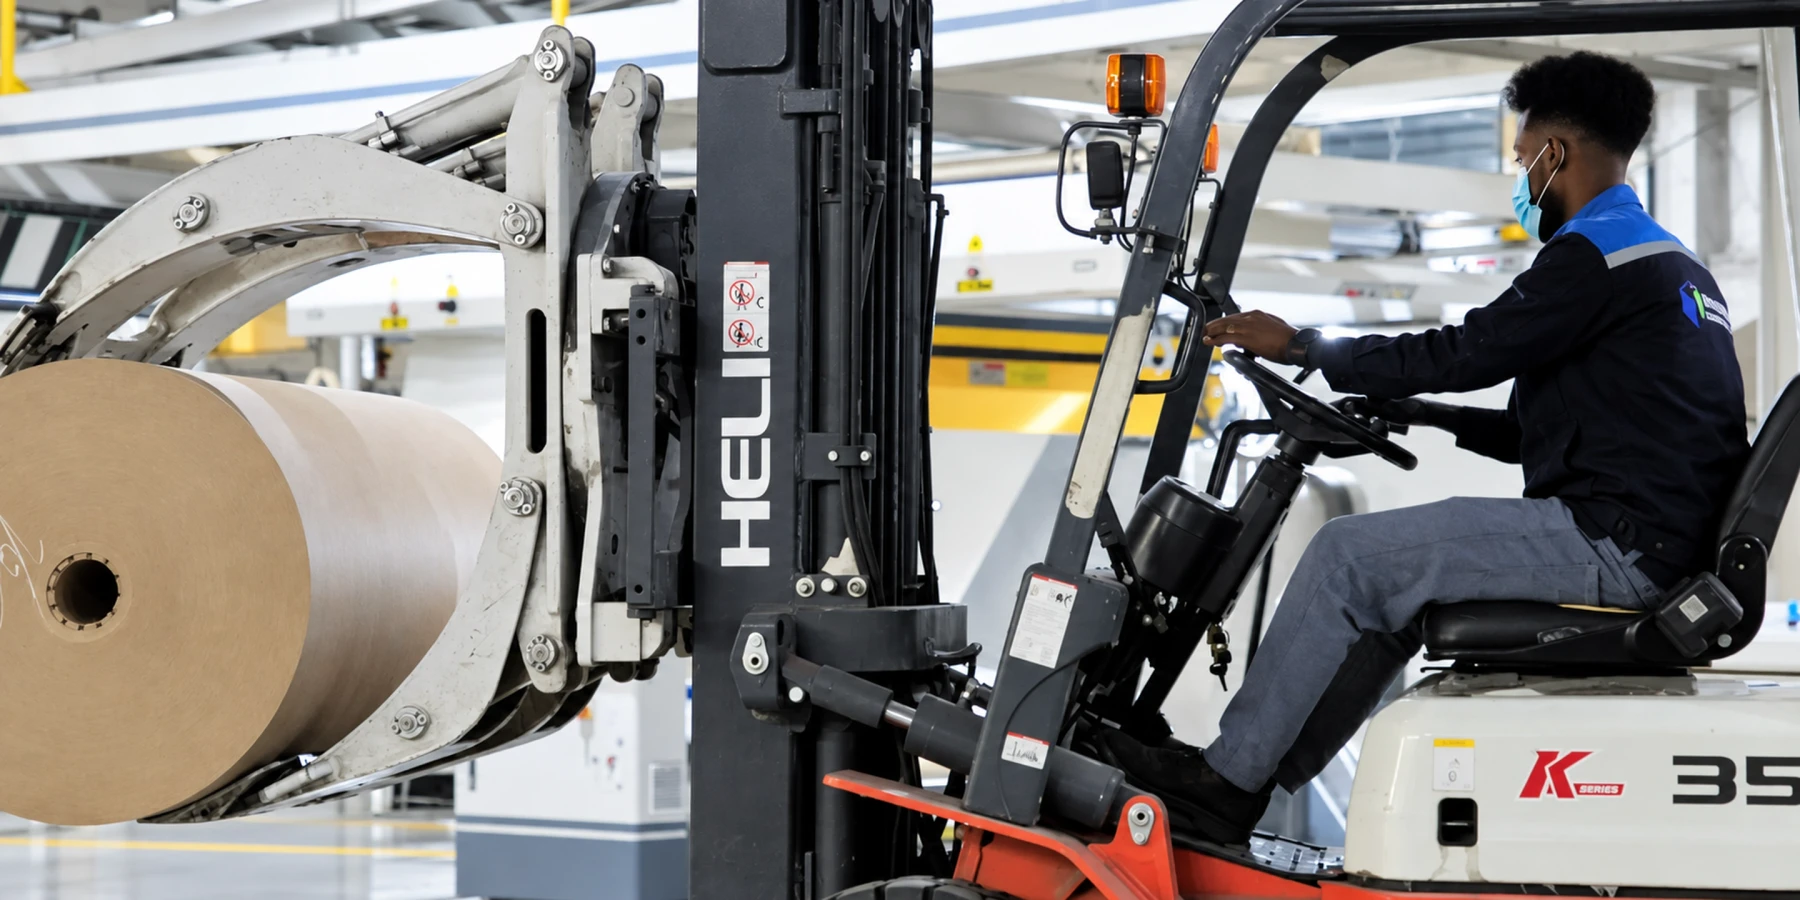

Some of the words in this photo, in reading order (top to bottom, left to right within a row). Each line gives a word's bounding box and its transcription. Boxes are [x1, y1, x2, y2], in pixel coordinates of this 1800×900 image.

[721, 358, 771, 567] HELI
[1519, 751, 1593, 799] K
[1579, 785, 1619, 794] SERIES
[1673, 756, 1800, 805] 35
